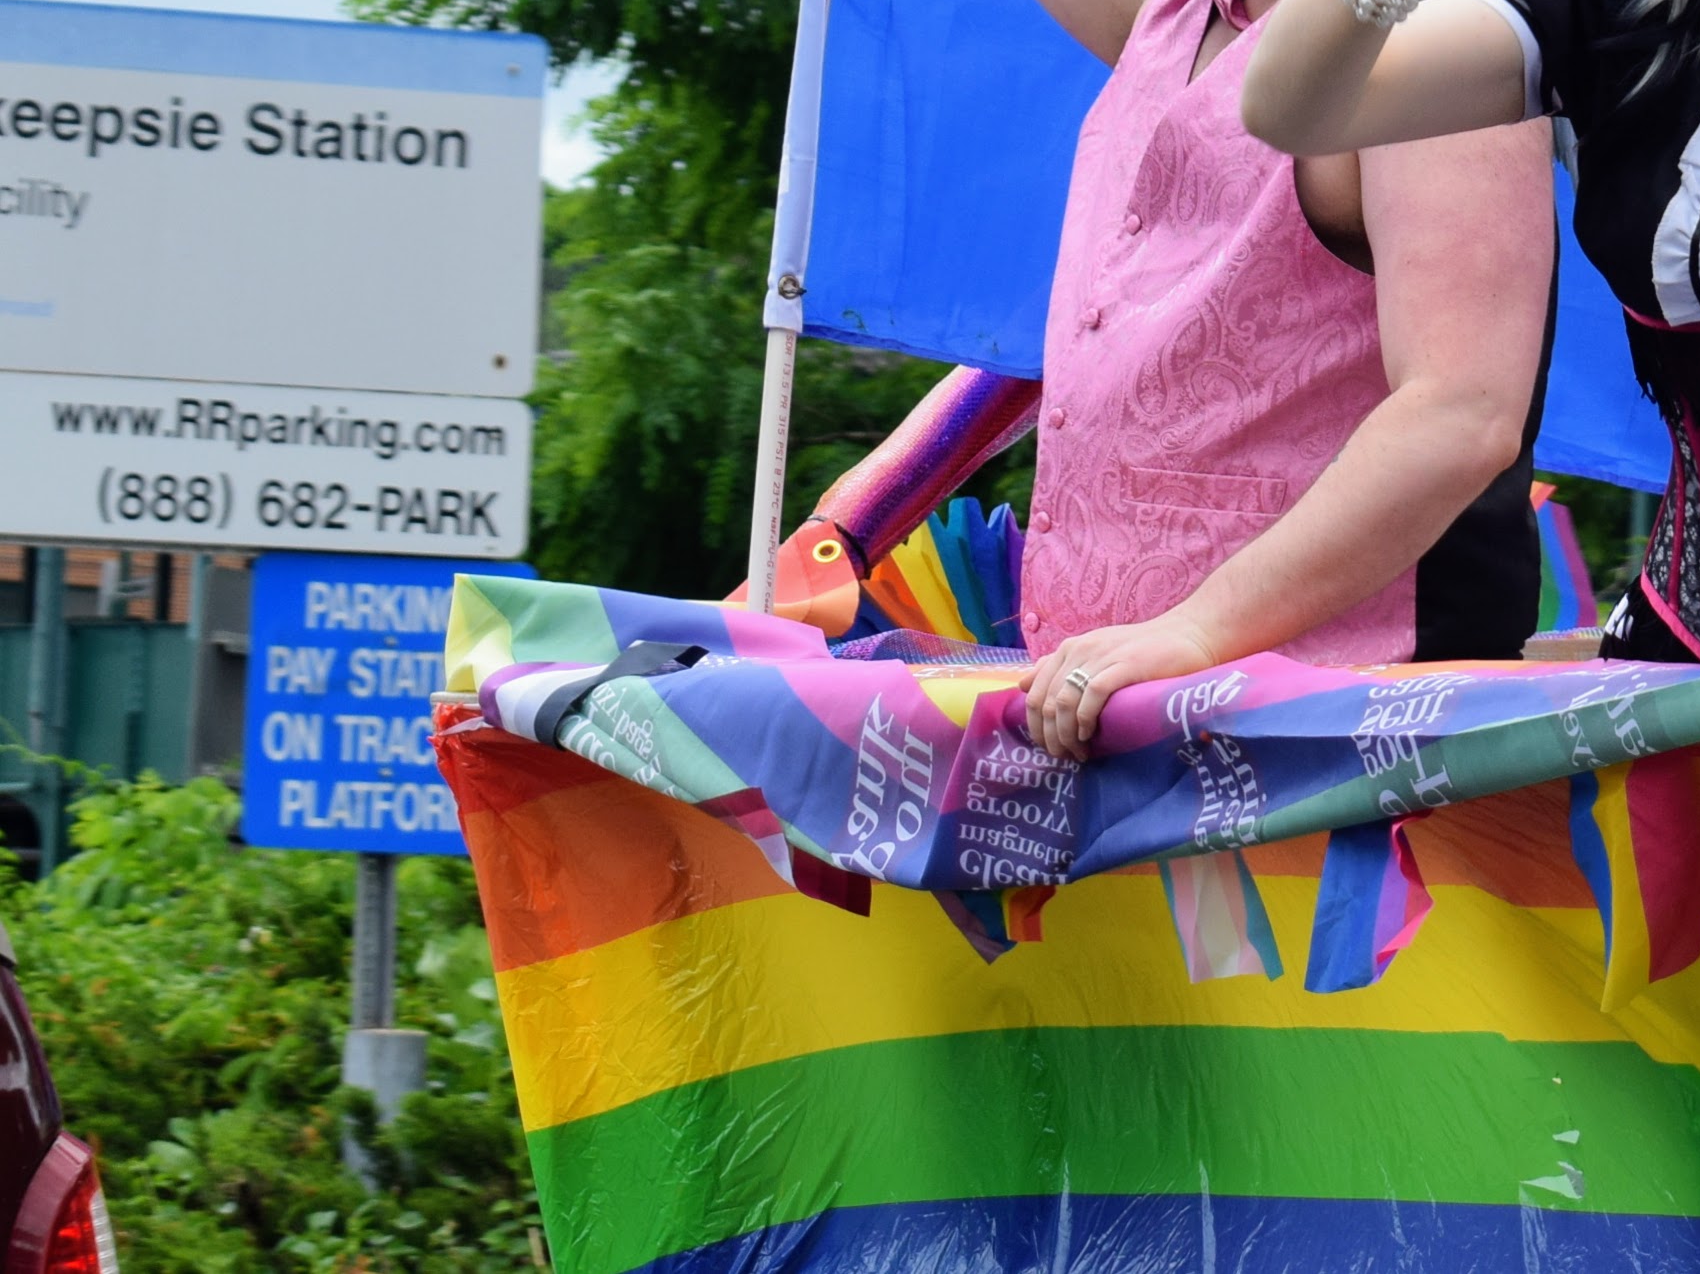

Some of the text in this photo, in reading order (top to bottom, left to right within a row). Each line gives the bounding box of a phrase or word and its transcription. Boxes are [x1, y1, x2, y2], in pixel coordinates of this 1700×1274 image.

[0, 96, 470, 169] eepsie Station
[51, 397, 507, 459] www.RRparking.com
[775, 441, 785, 462] PSI
[777, 415, 787, 436] 315
[97, 467, 499, 538] (888) 682-PARK
[265, 645, 446, 699] PAY STATI
[261, 711, 435, 766] ON TRAC
[279, 779, 461, 833] PLATFOR
